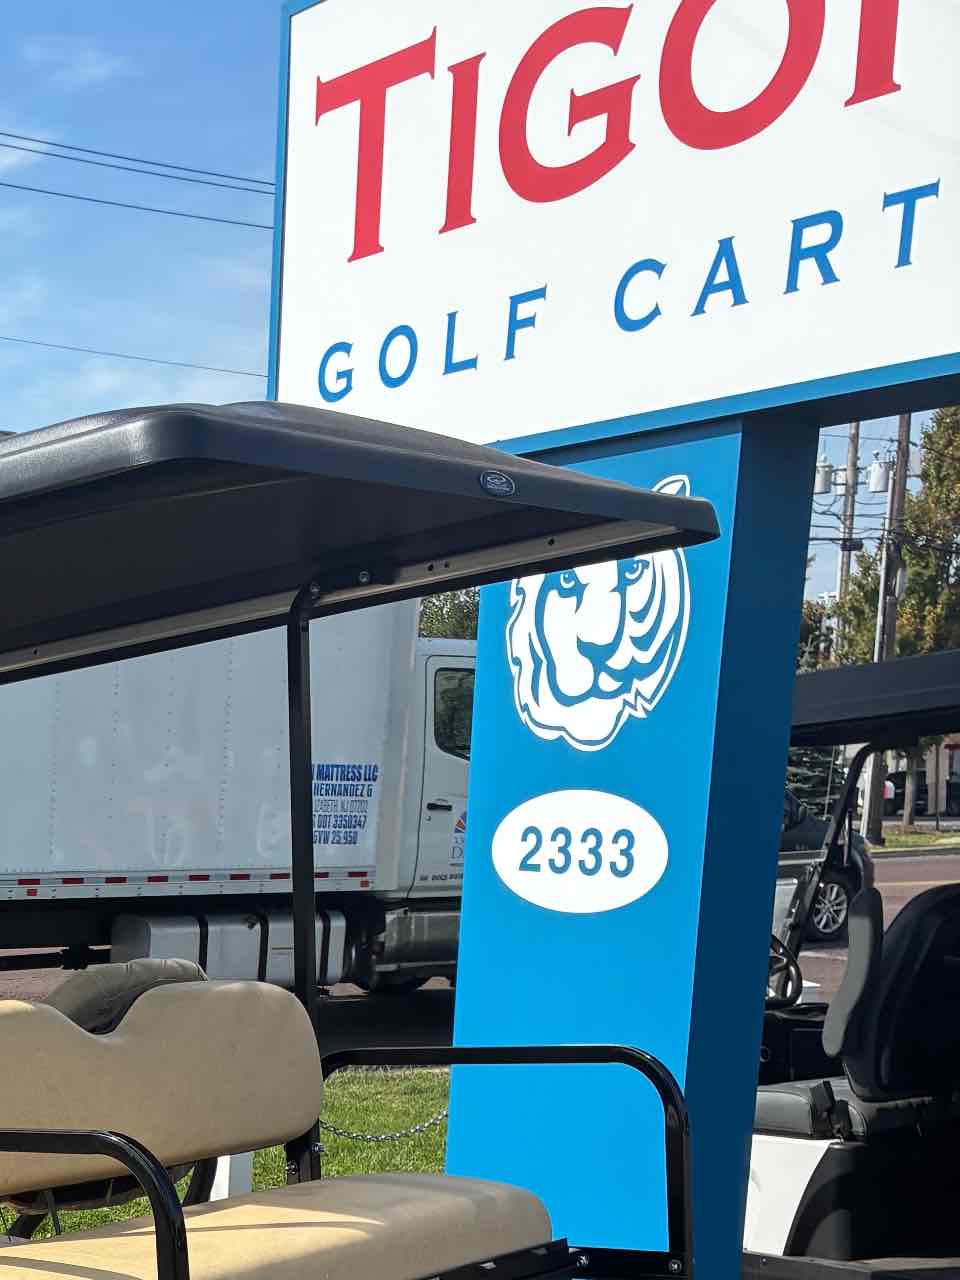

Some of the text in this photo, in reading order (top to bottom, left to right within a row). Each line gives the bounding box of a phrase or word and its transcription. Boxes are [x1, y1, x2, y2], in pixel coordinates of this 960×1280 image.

[318, 180, 940, 404] GOLF CART
[313, 783, 365, 797] HERNANDEZ
[316, 763, 379, 782] MATTRESS LLC
[518, 826, 635, 878] 2333
